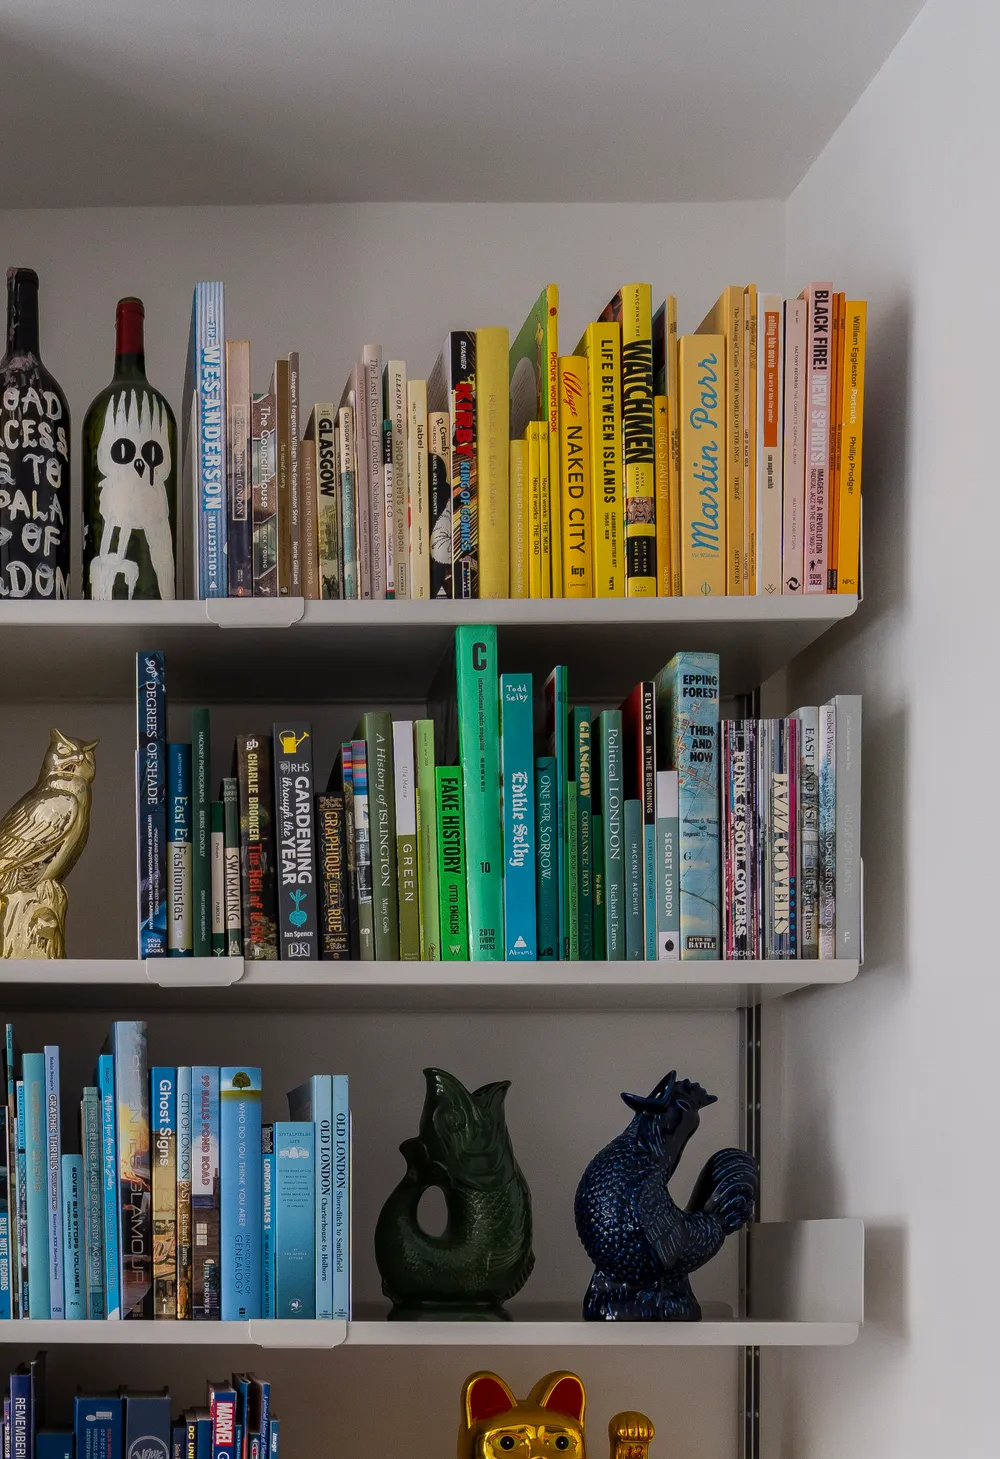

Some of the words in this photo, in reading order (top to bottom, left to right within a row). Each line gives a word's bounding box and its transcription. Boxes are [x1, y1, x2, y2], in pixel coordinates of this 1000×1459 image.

[207, 321, 217, 340] THE
[812, 290, 829, 333] BLACK
[203, 344, 221, 393] WES
[369, 358, 379, 375] The
[601, 339, 614, 370] LIFE
[812, 337, 828, 371] FIRE!
[370, 375, 379, 397] Lost
[562, 371, 583, 417] Weegee
[623, 339, 654, 464] WATCHMEN
[690, 352, 718, 430] Parr
[811, 374, 828, 407] NEW
[260, 406, 271, 427] The
[370, 398, 379, 427] Rivers
[455, 383, 473, 459] KIRBY
[602, 376, 614, 440] BETWEEN
[203, 399, 221, 511] ANDERSON
[260, 429, 272, 471] Council
[369, 429, 380, 440] of
[416, 424, 424, 448] label
[810, 409, 827, 467] SPIRITS!
[23, 454, 62, 488] TO
[319, 418, 335, 497] GLASGOW
[371, 440, 380, 476] London
[459, 461, 470, 488] KING
[567, 426, 584, 499] NAKED
[603, 446, 616, 504] ISLANDS
[260, 473, 271, 508] House
[460, 490, 470, 505] OF
[691, 439, 719, 552] Martin
[21, 523, 60, 557] OF
[208, 515, 218, 577] COLLECTION
[459, 507, 470, 551] COMICS
[569, 507, 585, 554] CITY
[472, 642, 488, 671] C
[683, 674, 718, 686] EPPING
[683, 687, 718, 699] FOREST
[146, 680, 157, 738] DEGREES
[147, 742, 158, 759] OF
[376, 732, 386, 743] A
[690, 725, 714, 737] THEN
[692, 739, 712, 750] AND
[376, 747, 387, 791] History
[579, 721, 591, 799] GLASGOW
[608, 727, 620, 781] Political
[690, 752, 713, 763] NOW
[734, 751, 747, 800] FUNK
[147, 760, 158, 805] SHADE
[280, 777, 293, 819] through
[376, 794, 388, 807] of
[440, 777, 459, 811] FAKE
[511, 771, 529, 820] Edible
[283, 821, 294, 838] the
[294, 776, 312, 884] GARDENING
[609, 787, 620, 860] LONDON
[734, 803, 746, 816] &
[282, 837, 296, 886] YEAR
[324, 811, 340, 880] GRAPHIQUE
[379, 809, 390, 887] ISLINGTON
[442, 815, 461, 875] HISTORY
[510, 824, 530, 867] Selby
[735, 820, 746, 865] SOUL
[173, 845, 187, 921] Fashionistas
[227, 854, 240, 921] SWIMMING
[329, 882, 338, 893] DE
[403, 843, 414, 902] GREEN
[774, 838, 790, 935] COVERS
[328, 909, 341, 932] RUE
[330, 894, 338, 905] LA
[735, 869, 747, 936] COVERS
[158, 1079, 172, 1123] Ghost
[320, 1119, 330, 1143] OLD
[336, 1112, 346, 1136] OLD
[158, 1126, 172, 1166] Signs
[336, 1140, 346, 1189] LONDON
[320, 1147, 331, 1195] LONDON
[129, 1179, 144, 1284] GLAMOUR
[336, 1237, 344, 1273] Smithfield
[216, 1402, 234, 1445] MARVEL
